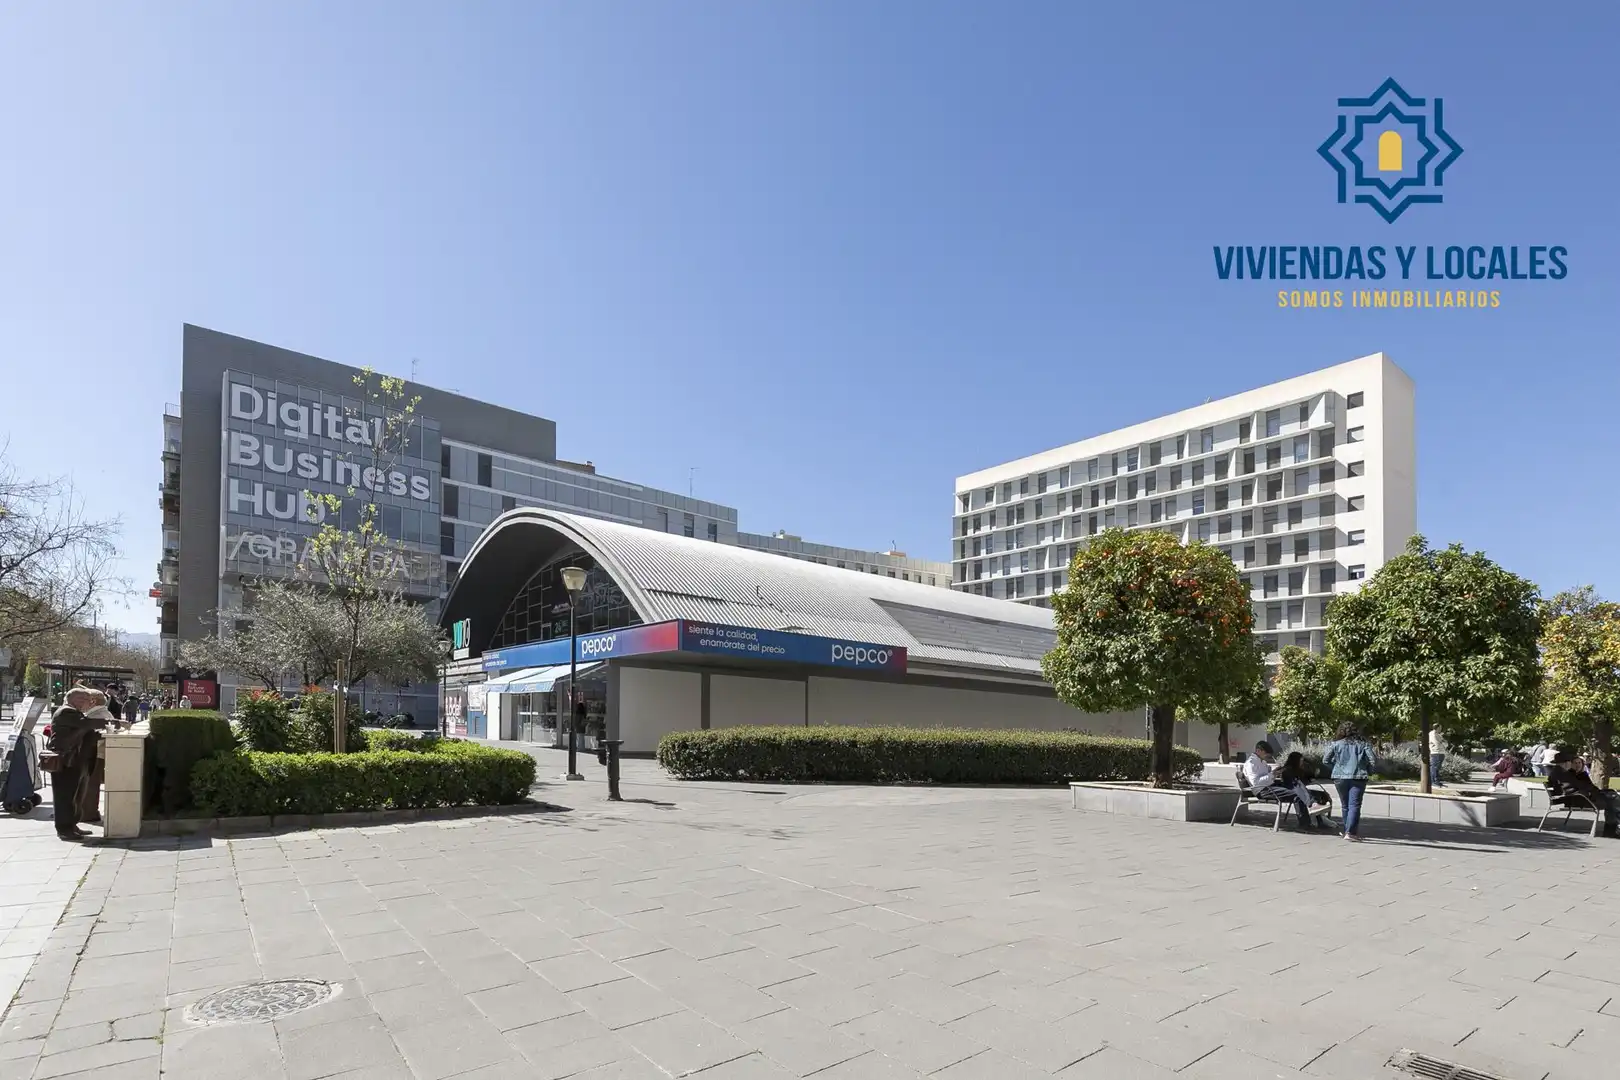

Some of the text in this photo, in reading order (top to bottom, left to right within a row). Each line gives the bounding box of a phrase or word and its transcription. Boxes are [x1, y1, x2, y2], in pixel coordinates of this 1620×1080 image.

[231, 383, 383, 447] Digital
[229, 478, 326, 523] Hub
[688, 625, 759, 642] siente la calidad,
[700, 638, 786, 655] enamórate del precio
